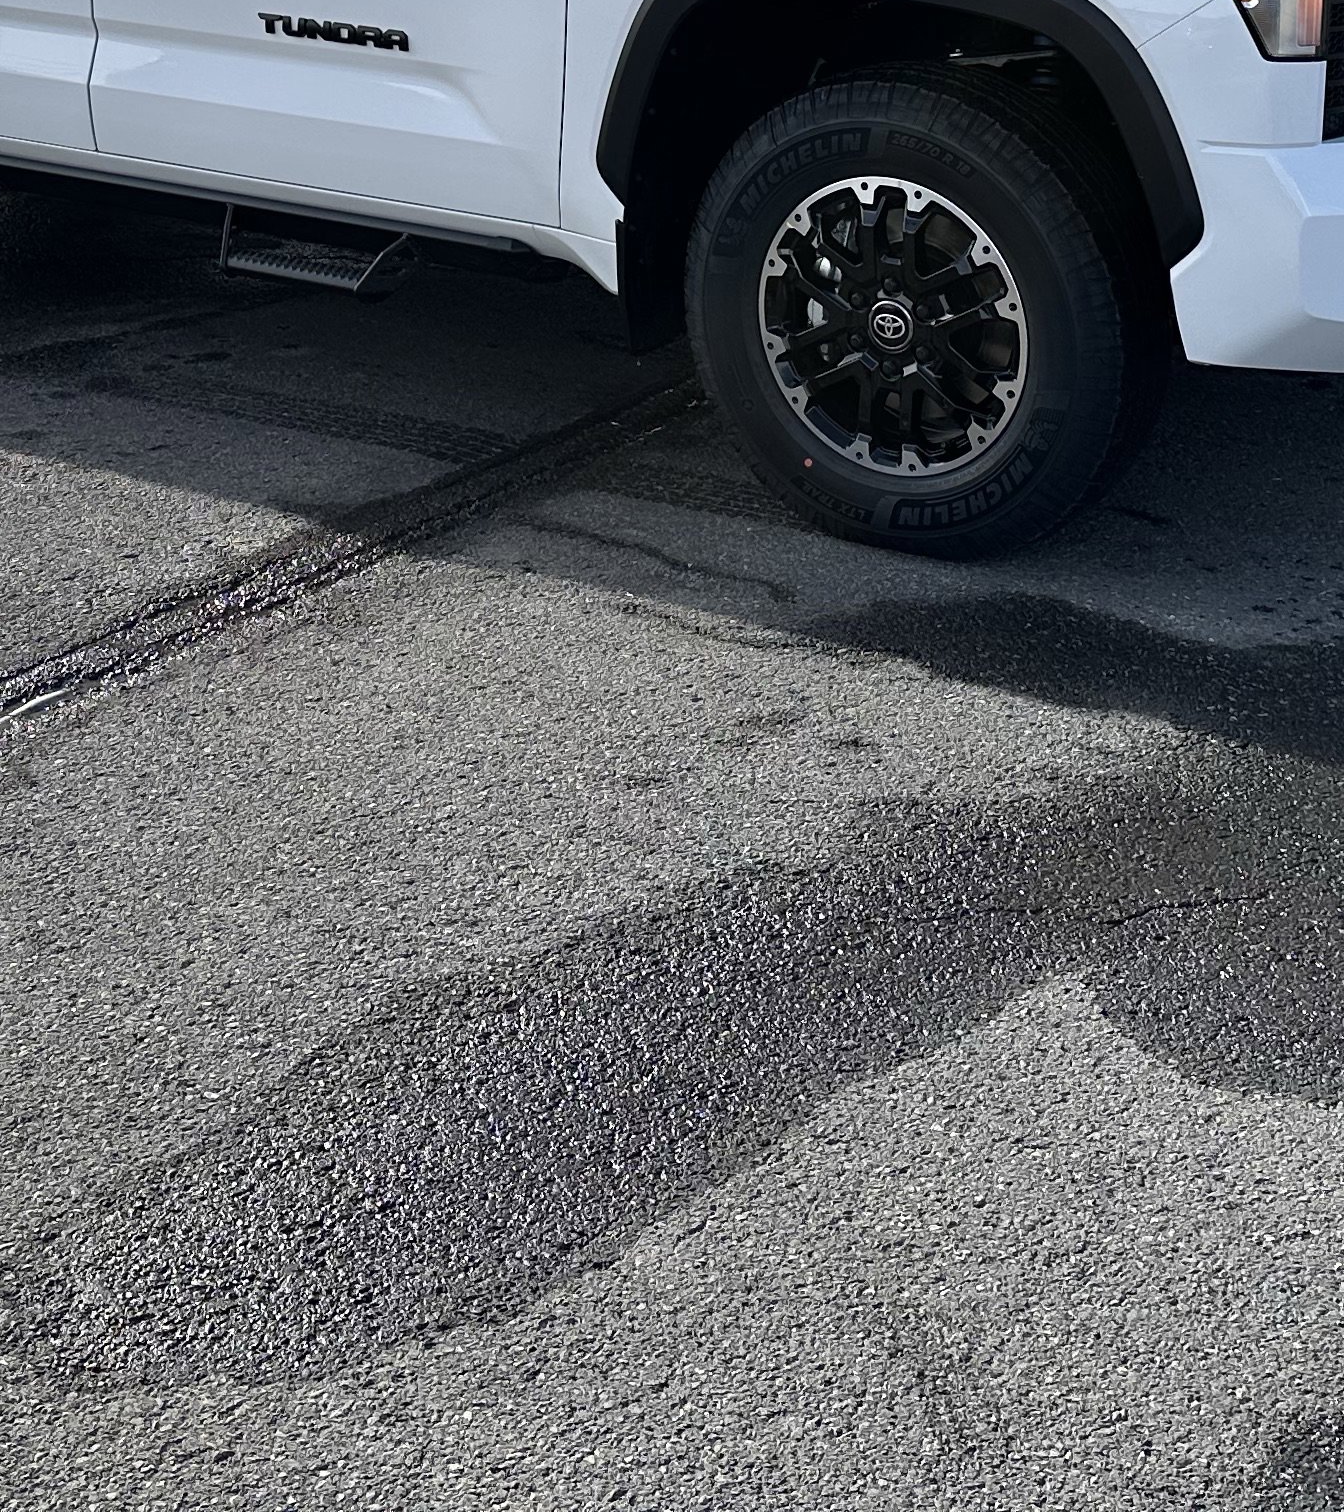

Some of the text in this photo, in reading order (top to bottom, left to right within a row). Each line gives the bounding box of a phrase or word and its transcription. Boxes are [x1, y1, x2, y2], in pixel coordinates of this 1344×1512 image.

[258, 12, 409, 52] TUNDRA
[739, 132, 863, 213] MICHELIN
[892, 133, 971, 176] 265/70 R 18
[897, 452, 1035, 526] MICHELIN
[837, 502, 866, 521] LTX
